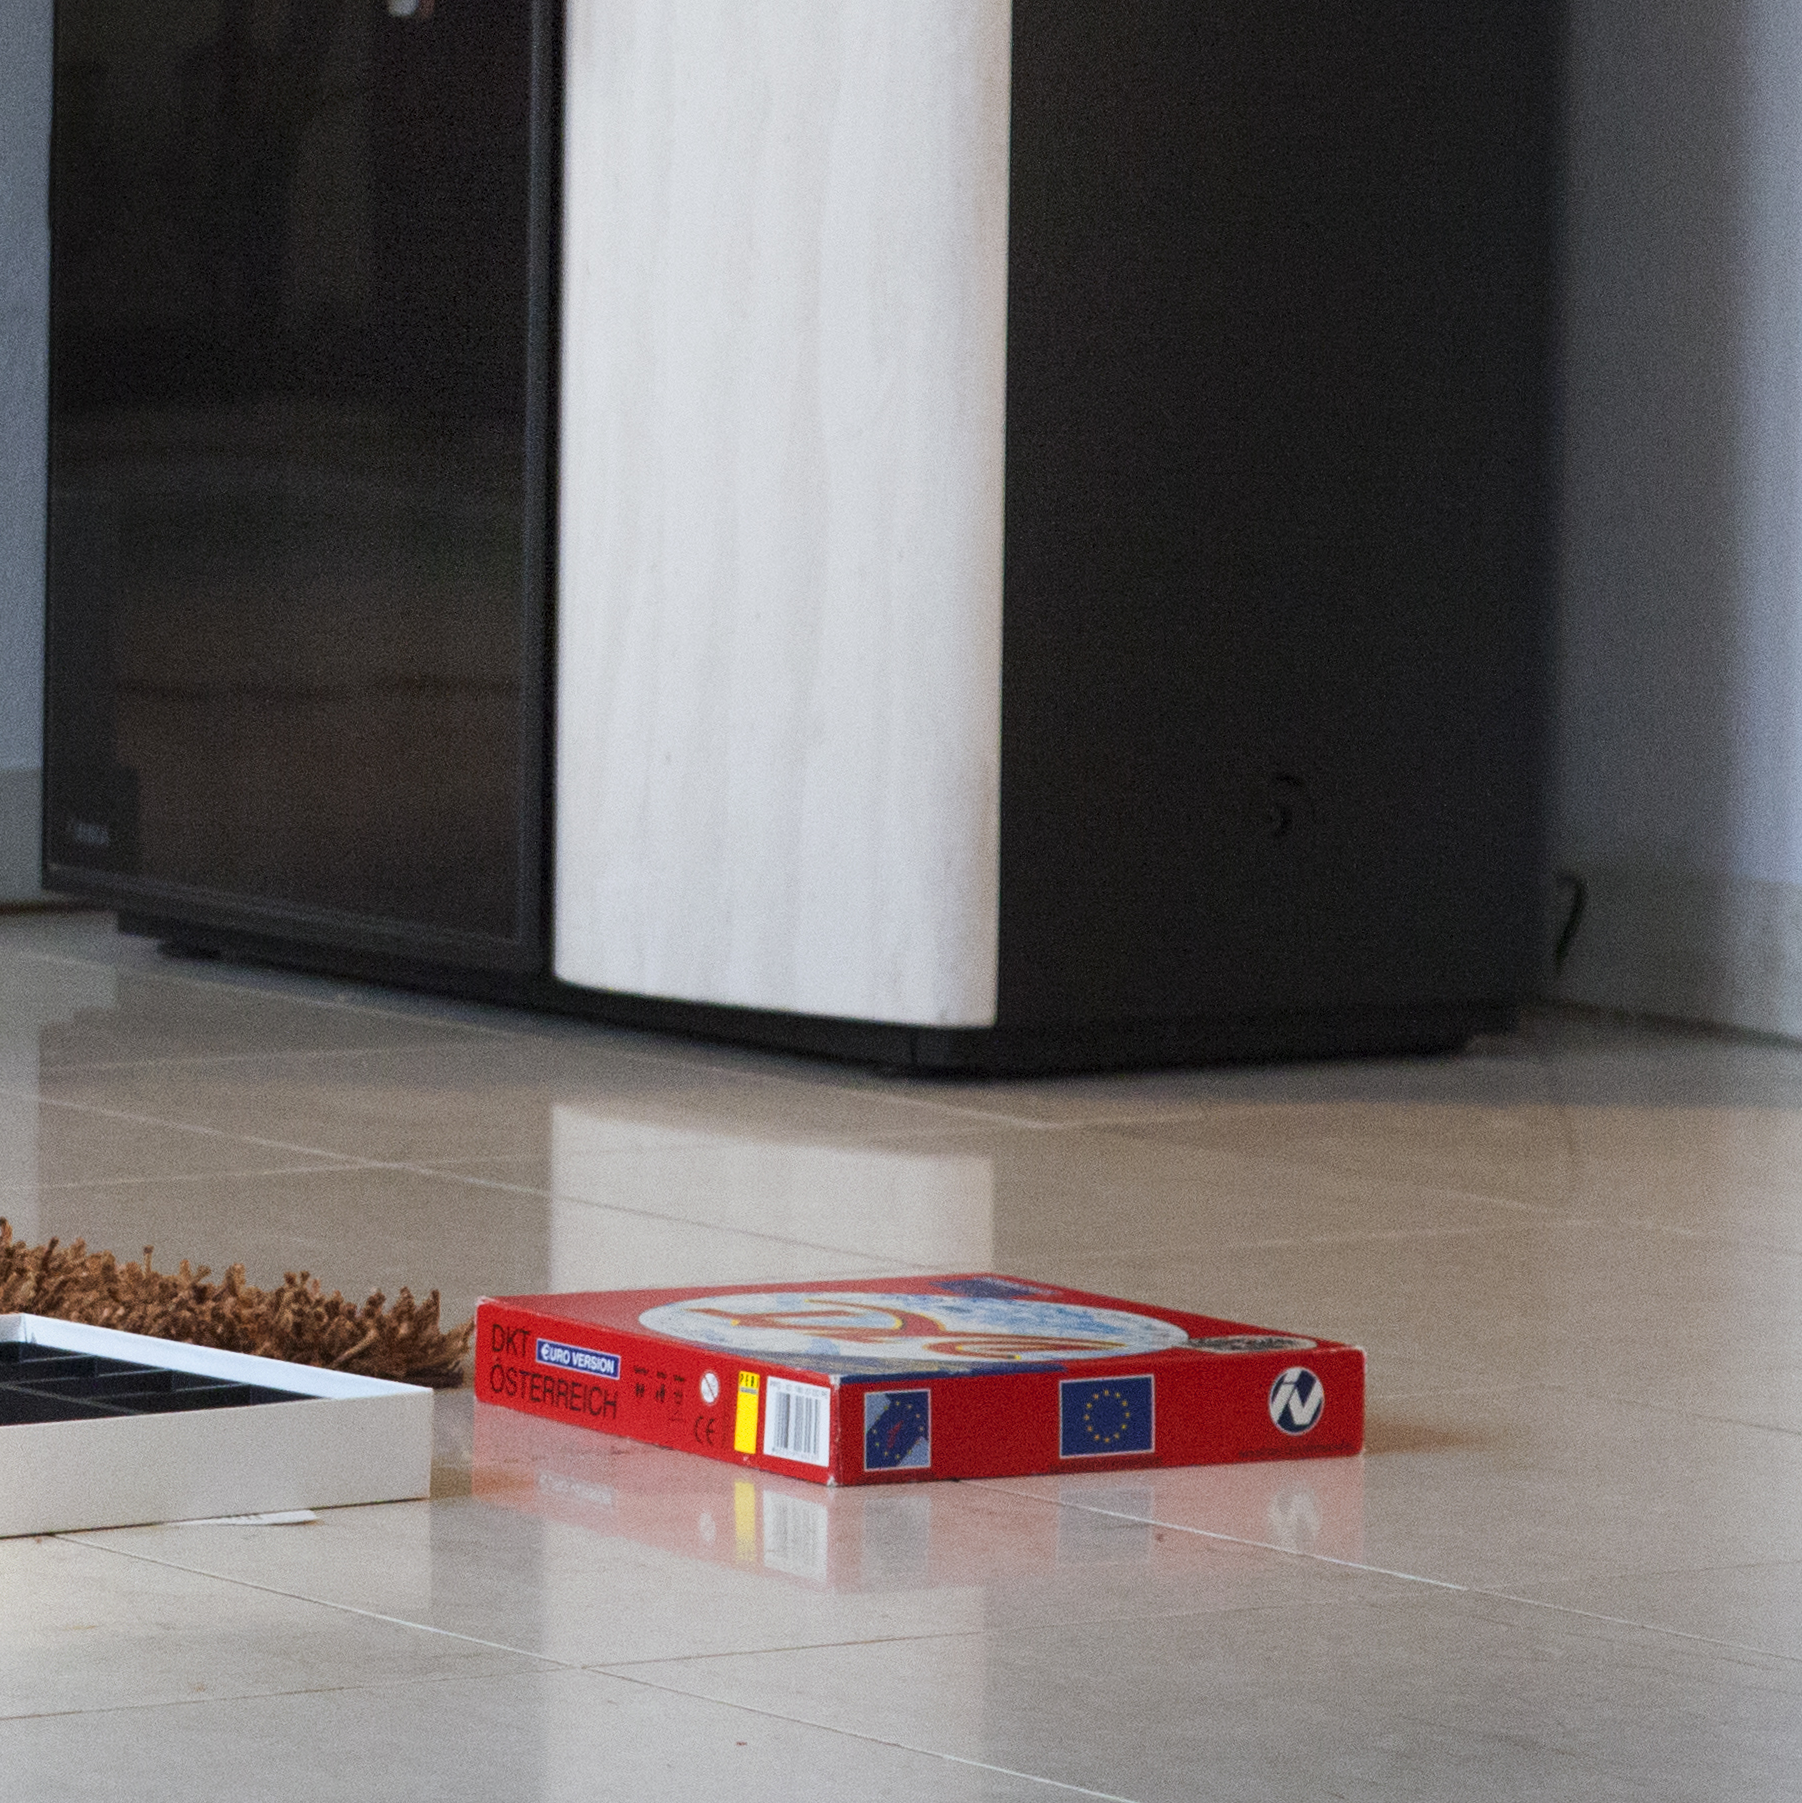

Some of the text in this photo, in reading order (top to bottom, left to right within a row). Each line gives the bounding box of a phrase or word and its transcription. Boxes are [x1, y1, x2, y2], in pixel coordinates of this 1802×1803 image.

[492, 1324, 531, 1357] DKT
[572, 1351, 615, 1374] VERSION
[490, 1357, 618, 1420] ÖSTERREICH
